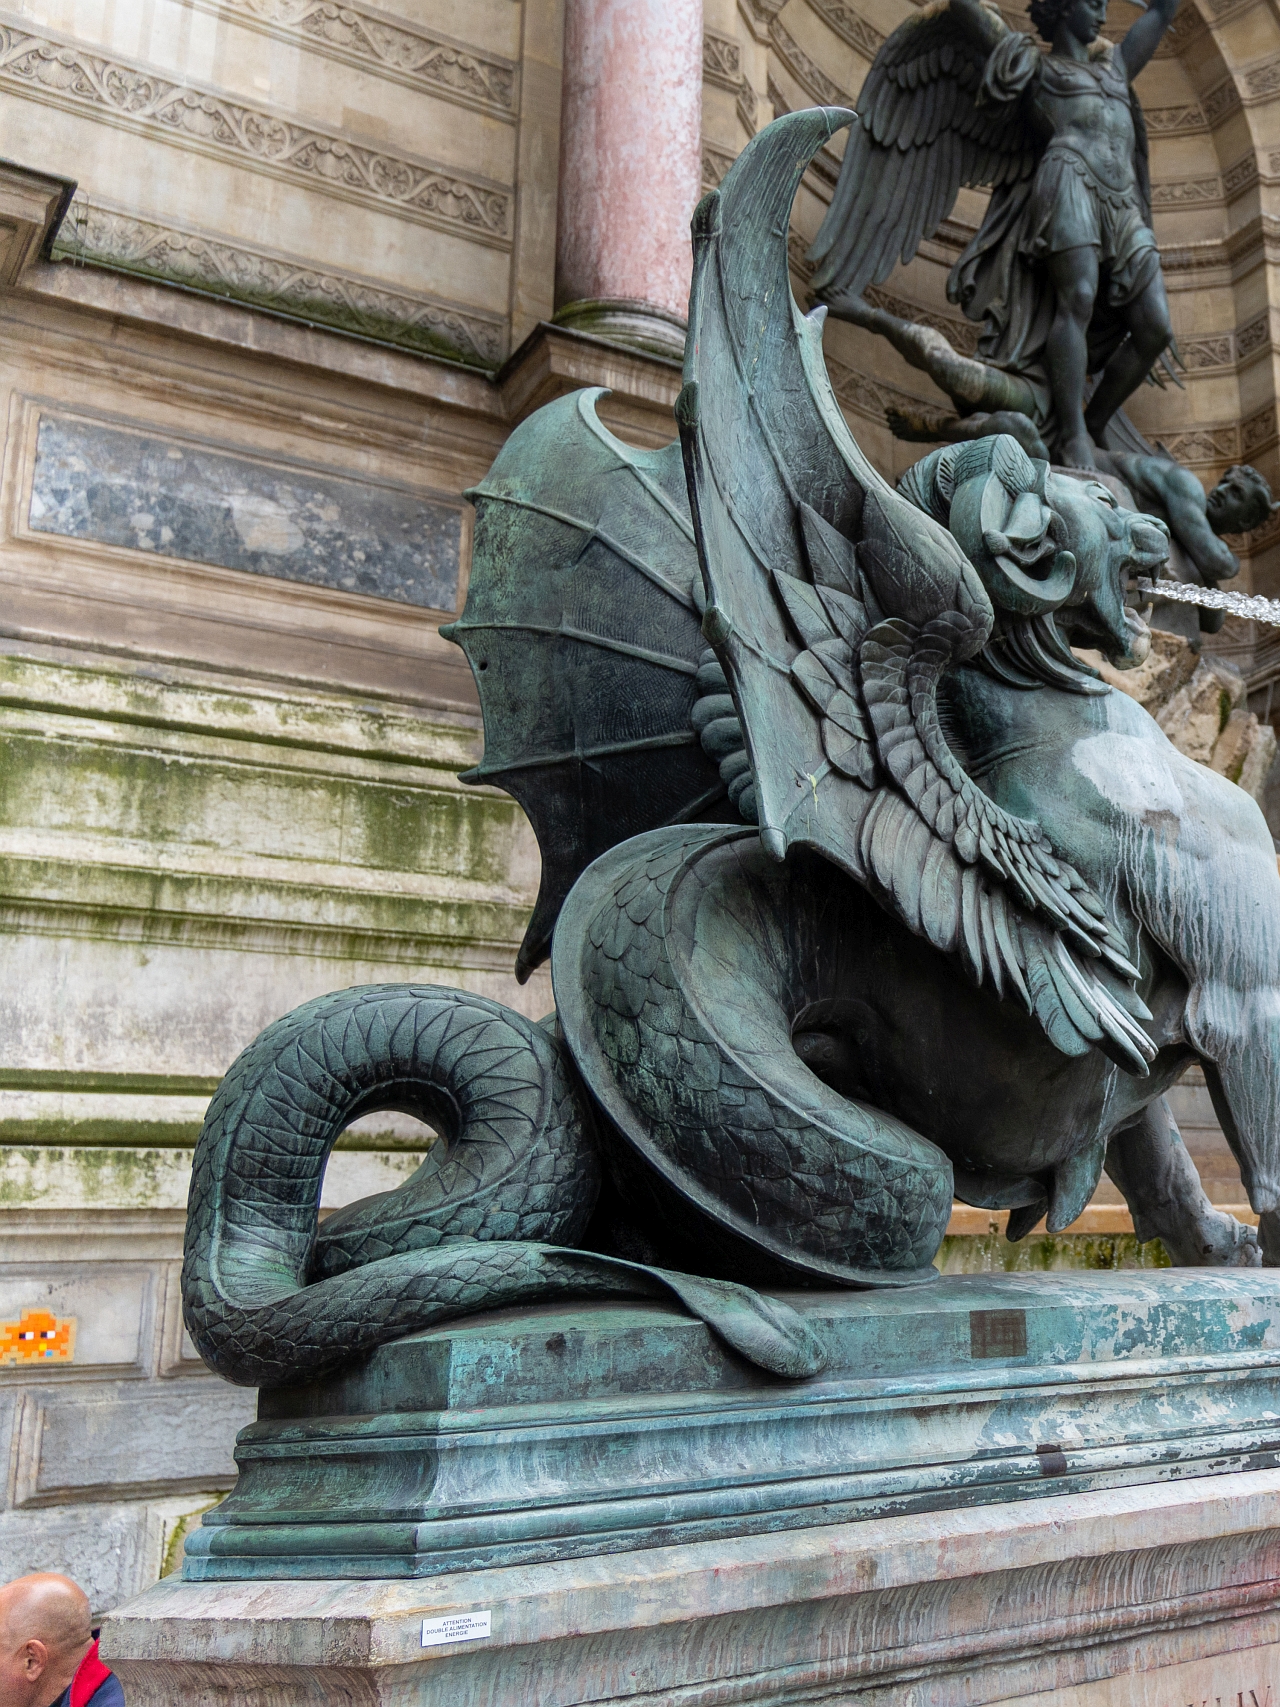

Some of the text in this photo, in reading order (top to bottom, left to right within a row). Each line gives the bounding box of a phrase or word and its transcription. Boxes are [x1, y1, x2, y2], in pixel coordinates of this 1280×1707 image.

[442, 1617, 472, 1627] ATTENTION
[426, 1621, 488, 1635] DOUBLE ALIMENTATION
[445, 1630, 469, 1638] ENERGIE
